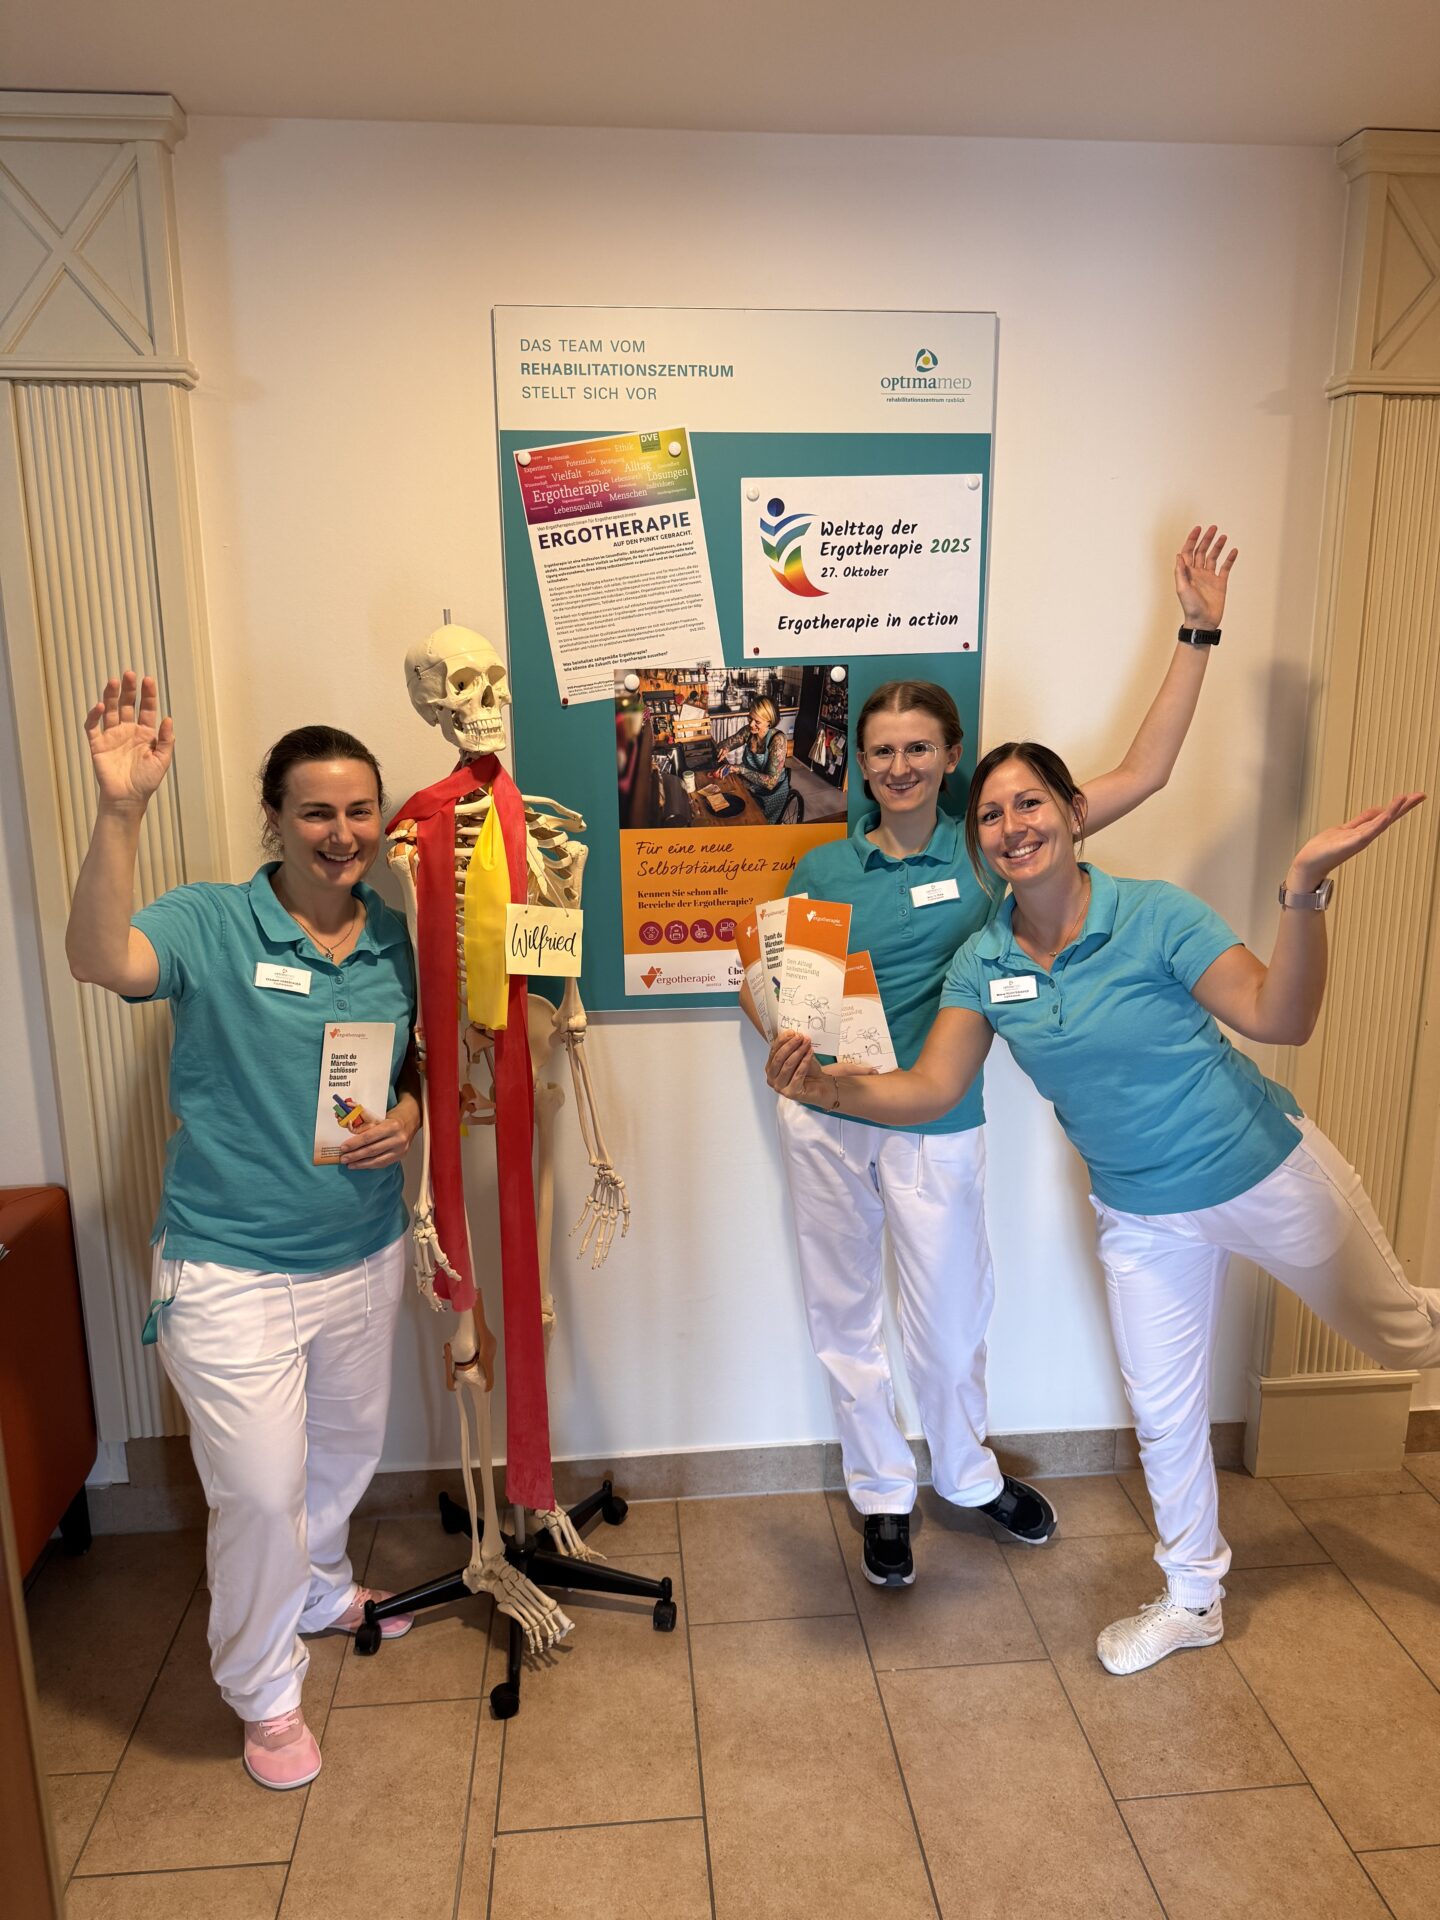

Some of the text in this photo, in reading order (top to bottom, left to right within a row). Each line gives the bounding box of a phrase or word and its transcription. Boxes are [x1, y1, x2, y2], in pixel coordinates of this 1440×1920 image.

[520, 338, 645, 353] DAS TEAM VOM
[520, 362, 734, 378] REHABILITATIONSZENTRUM
[881, 376, 972, 390] optimamed
[521, 386, 657, 401] STELLT SICH VOR
[640, 432, 658, 443] DVE
[624, 460, 652, 473] Alltag
[552, 469, 582, 482] Vielfalt
[532, 480, 610, 504] Ergotherapie
[609, 488, 648, 502] Menschen
[553, 500, 603, 515] Lebensqualität
[538, 510, 690, 550] ERGOTHERAPIE
[639, 535, 659, 543] PUNKT
[660, 529, 692, 539] GEBRACHT.
[821, 518, 918, 540] Welttag der
[820, 538, 972, 561] Ergotherapie 2025
[821, 566, 889, 578] 27. Oktober
[778, 612, 958, 635] Ergotherapie in action
[636, 841, 734, 855] Für eine neue
[637, 890, 670, 898] Kennen
[672, 889, 685, 897] Sie
[686, 888, 711, 896] schon
[638, 897, 753, 909] Bereiche der Ergotherapie?
[512, 923, 576, 967] Wilfried
[728, 966, 744, 975] Übe
[656, 973, 716, 985] ergotherapie
[728, 978, 741, 986] Sie
